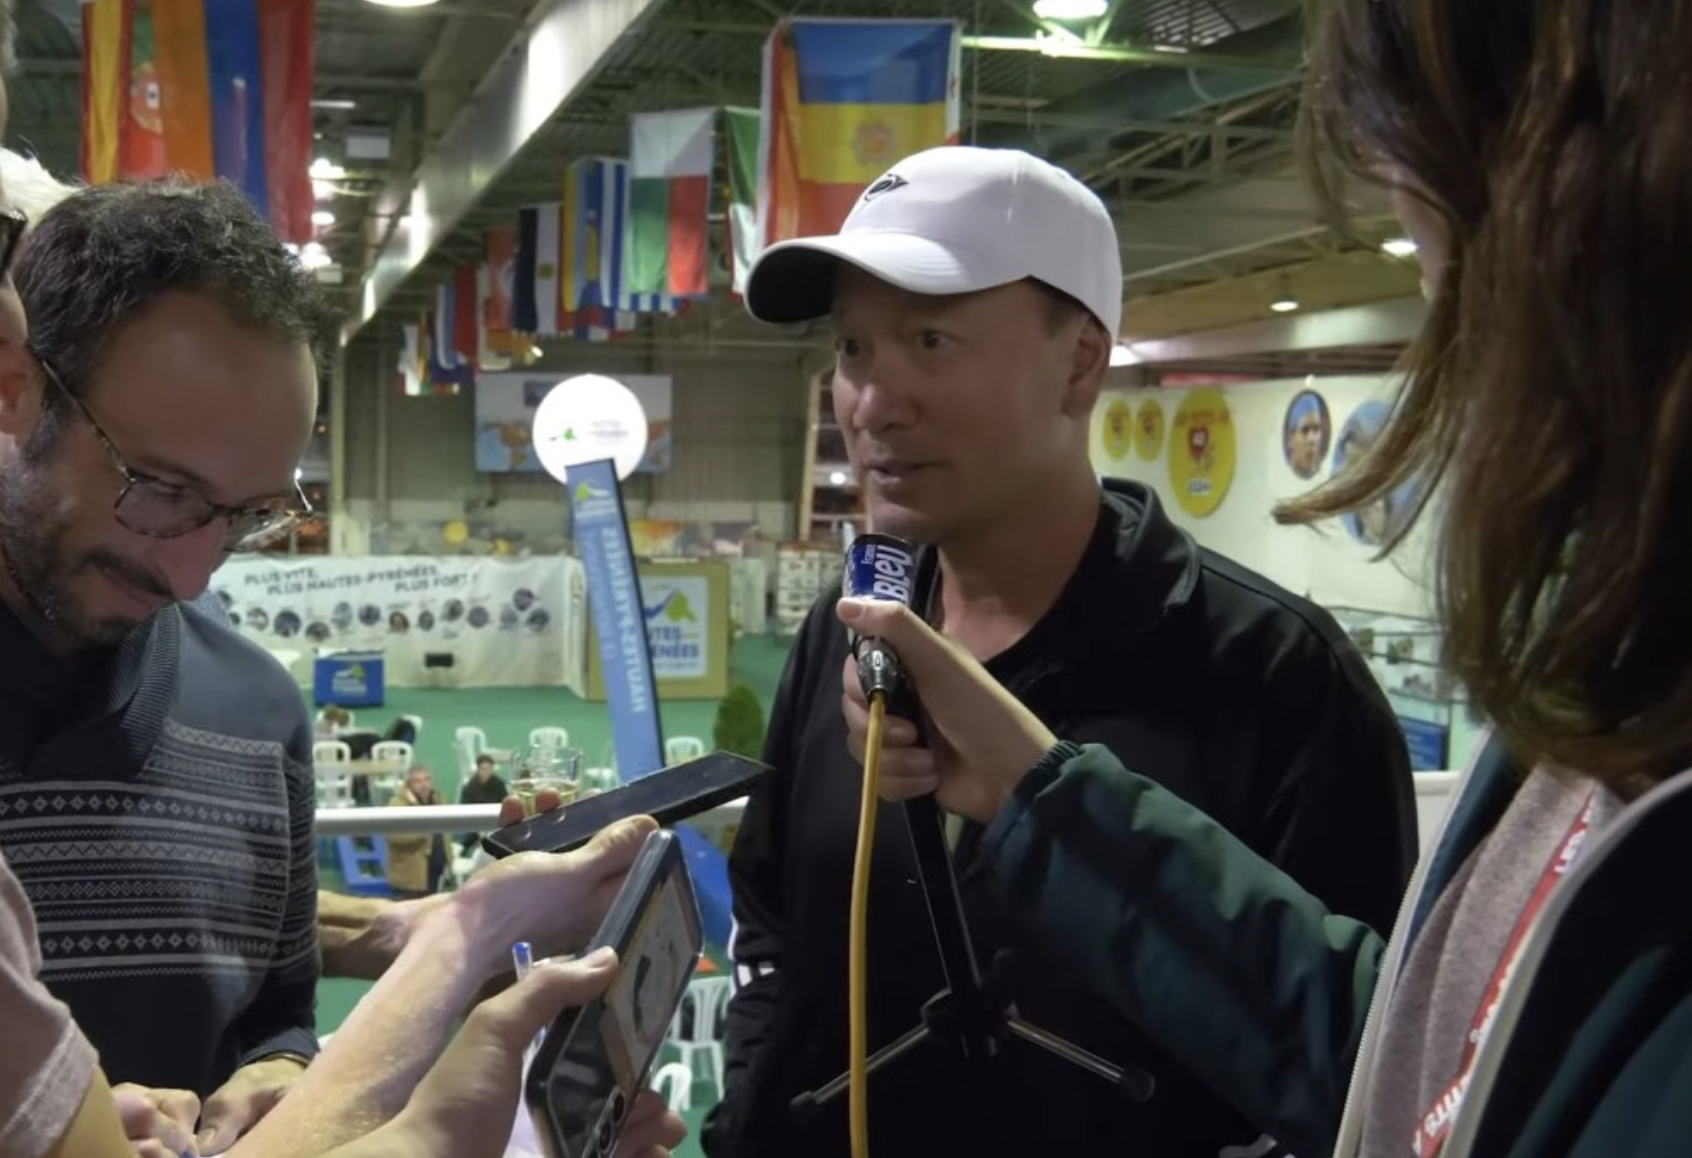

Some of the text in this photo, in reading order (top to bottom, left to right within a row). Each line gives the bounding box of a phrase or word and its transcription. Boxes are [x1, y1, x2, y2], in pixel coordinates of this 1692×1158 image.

[244, 572, 280, 586] PLUS
[394, 578, 430, 593] PLUS
[267, 582, 303, 596] PLUS
